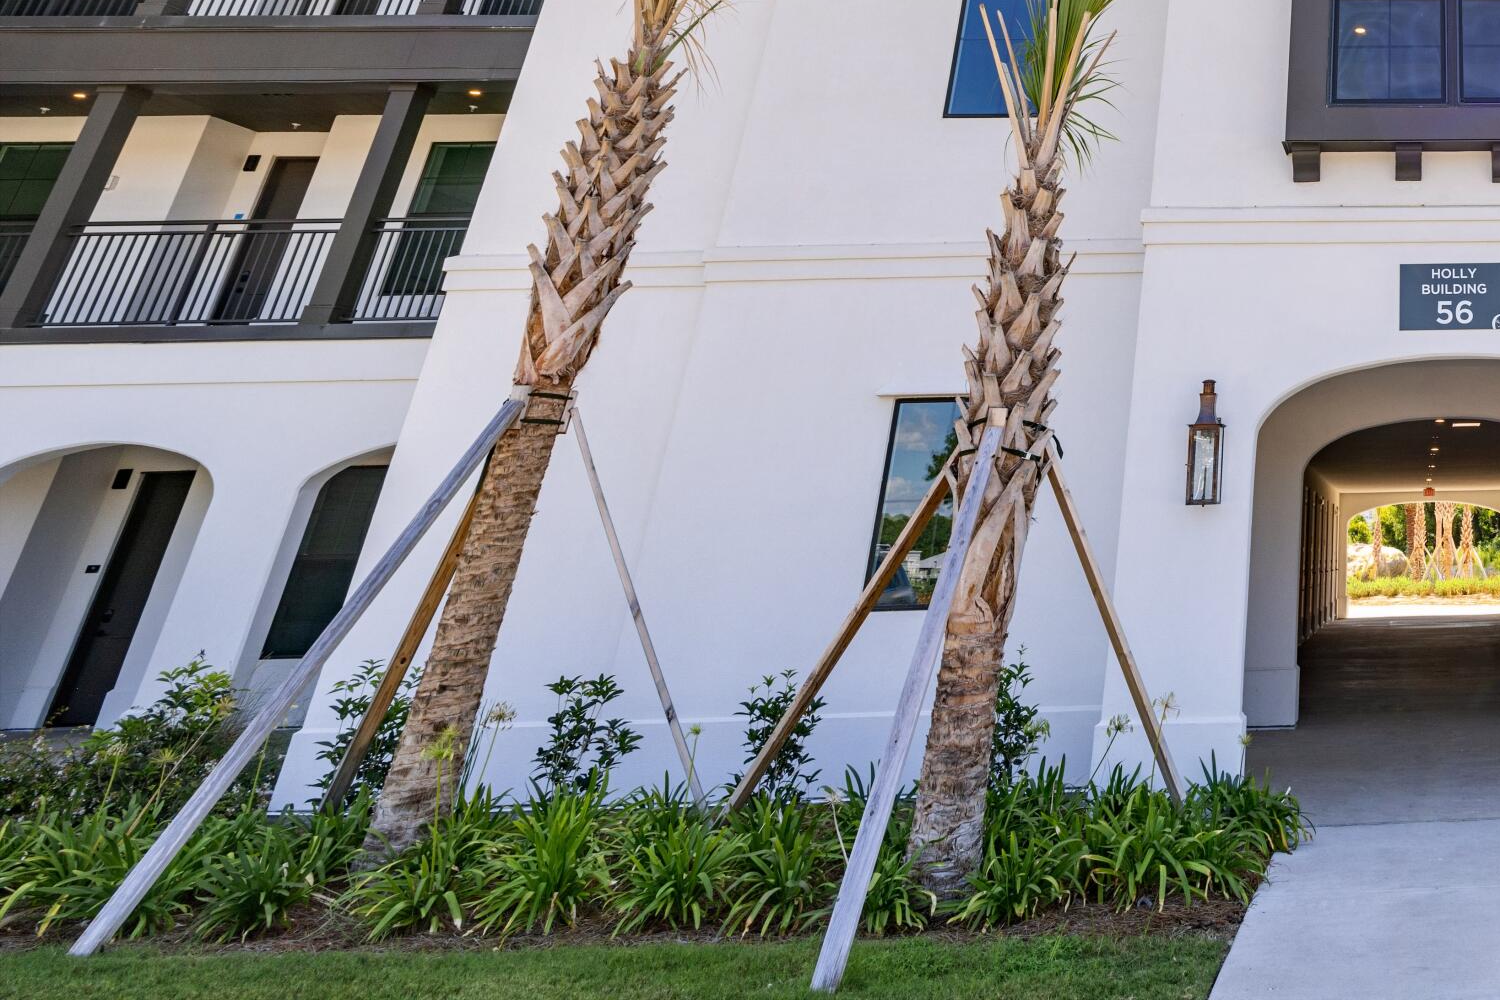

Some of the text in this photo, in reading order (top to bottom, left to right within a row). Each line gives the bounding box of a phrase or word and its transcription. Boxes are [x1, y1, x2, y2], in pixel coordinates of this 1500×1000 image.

[1431, 268, 1477, 279] HOLLY
[1421, 283, 1487, 295] BUILDING
[1436, 300, 1474, 324] 56
